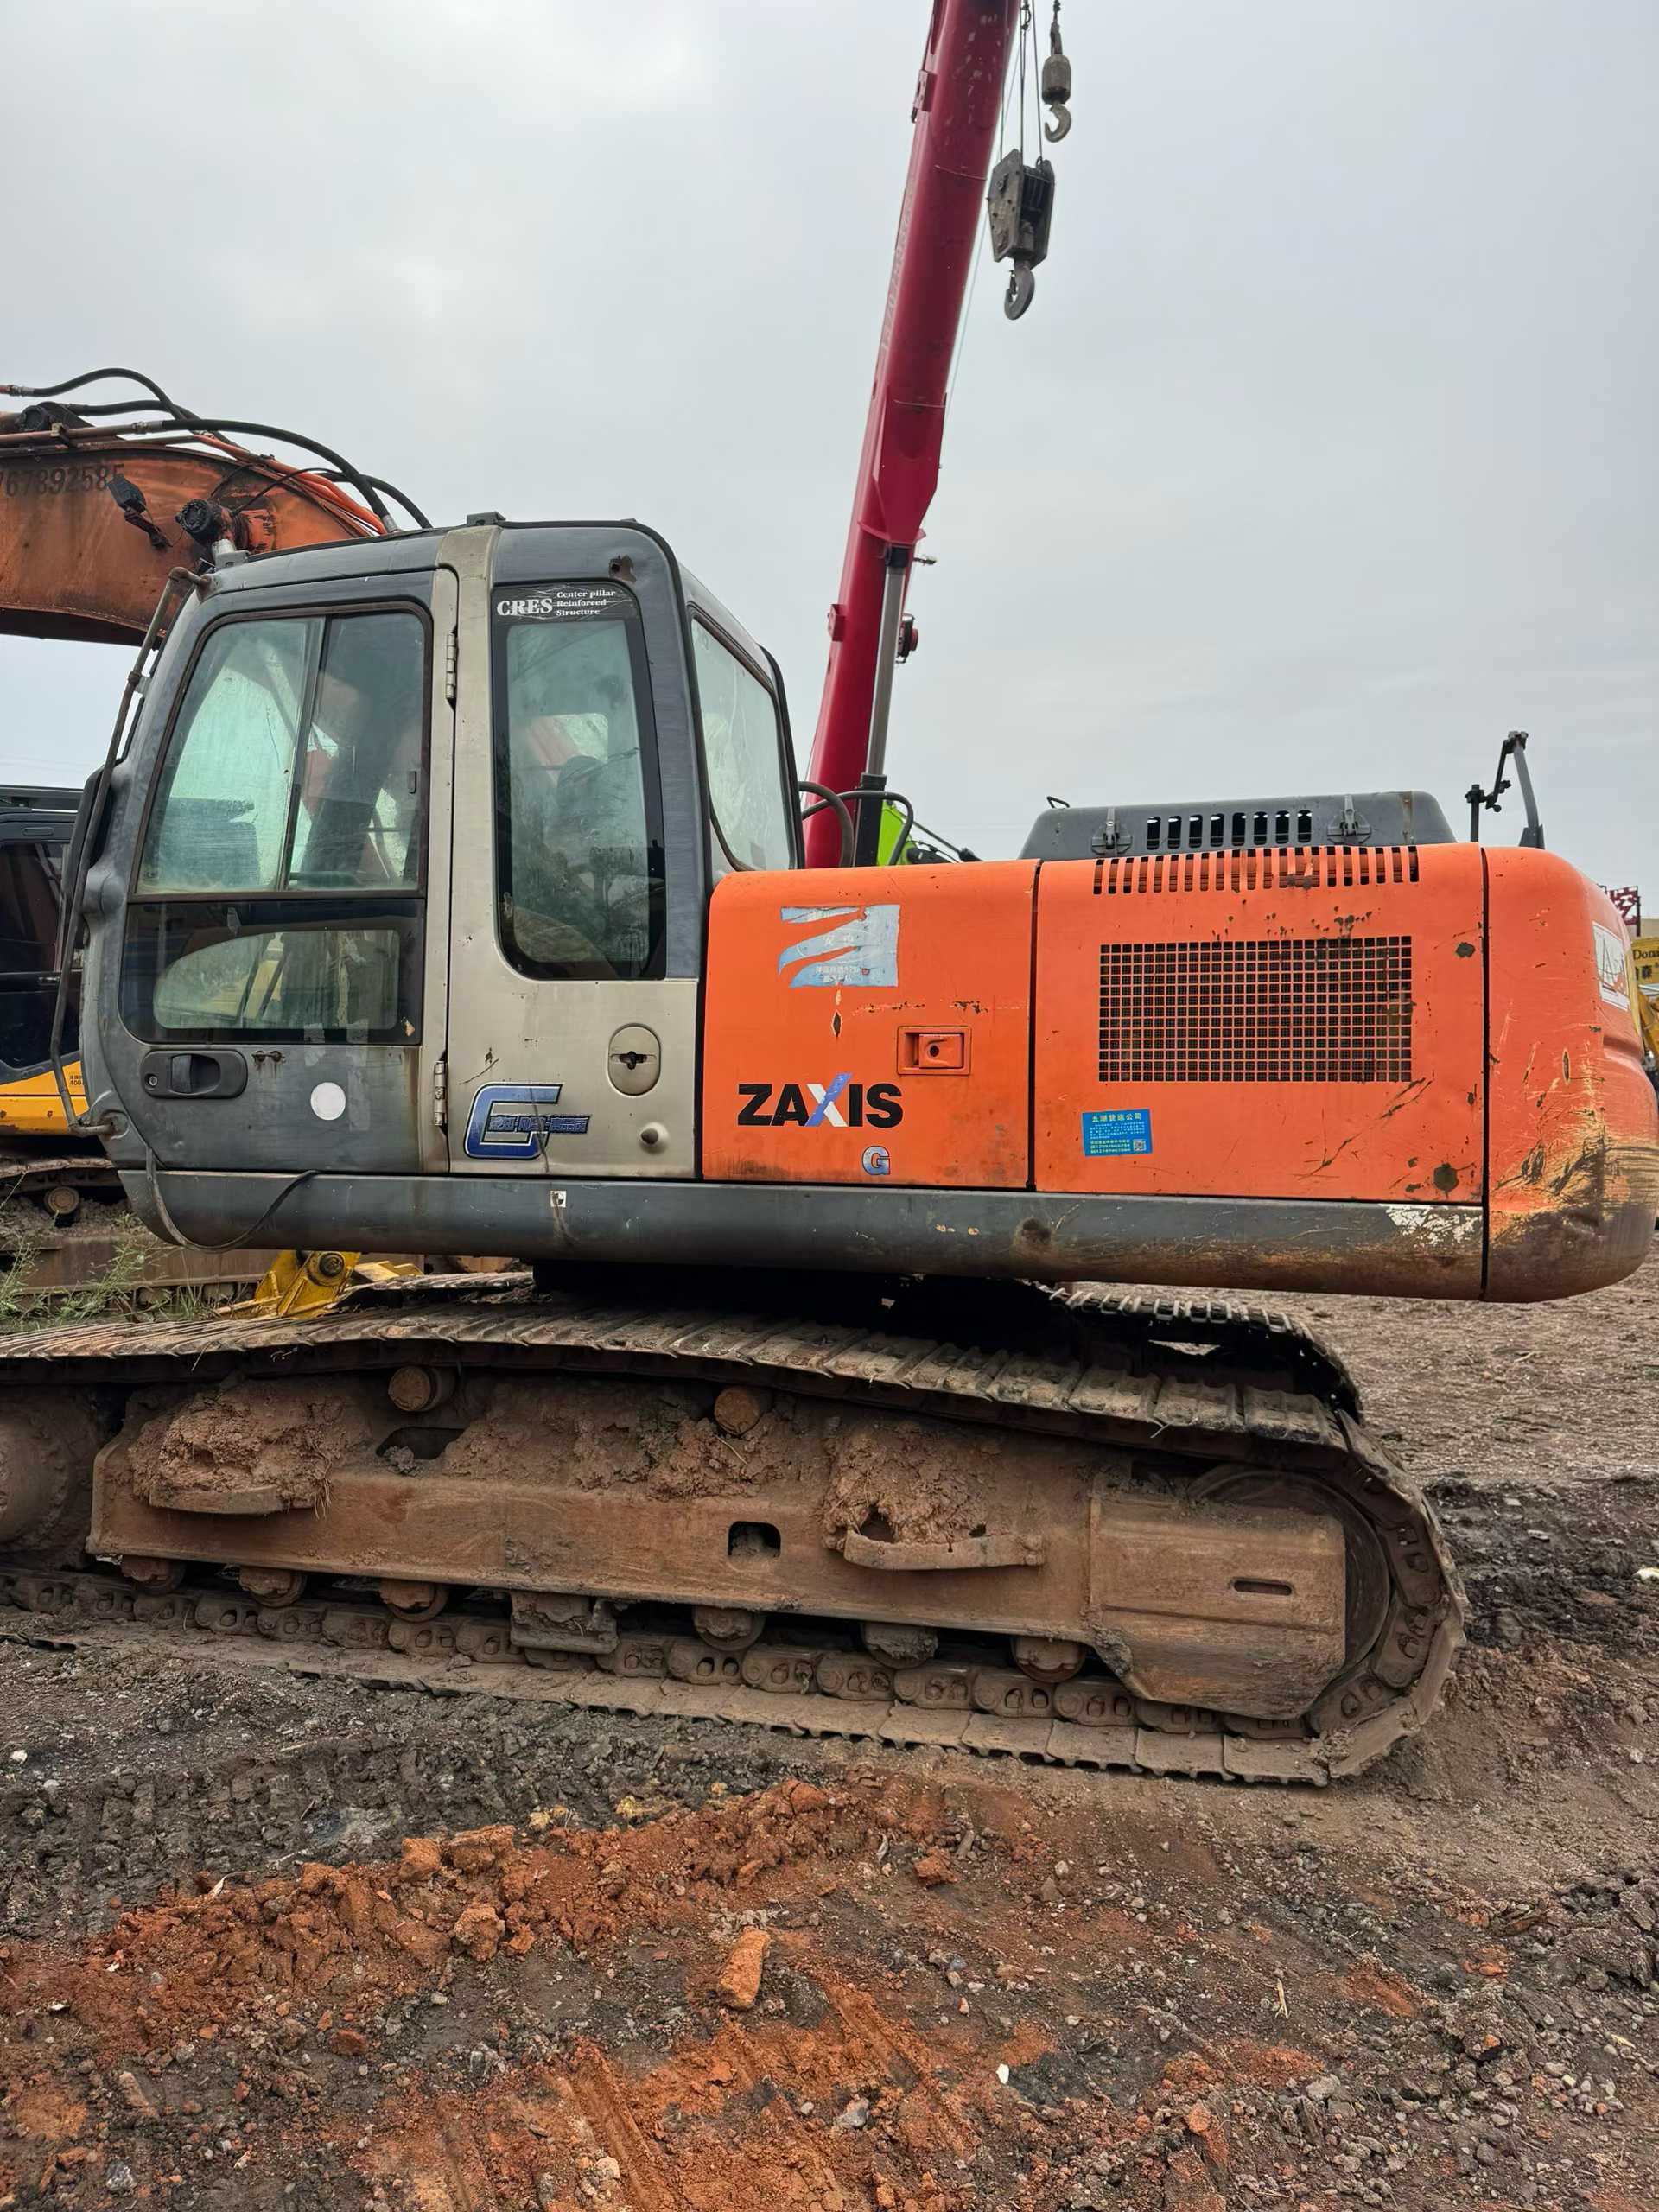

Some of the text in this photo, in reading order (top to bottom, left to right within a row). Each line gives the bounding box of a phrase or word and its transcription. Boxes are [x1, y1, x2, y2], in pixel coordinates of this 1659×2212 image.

[0, 463, 125, 497] 6789258
[556, 588, 616, 599] Center pillar
[556, 599, 607, 607] Reinforced
[496, 597, 553, 616] CRES
[556, 608, 601, 617] Structure
[737, 1072, 903, 1128] ZAXIS
[861, 1145, 891, 1176] G
